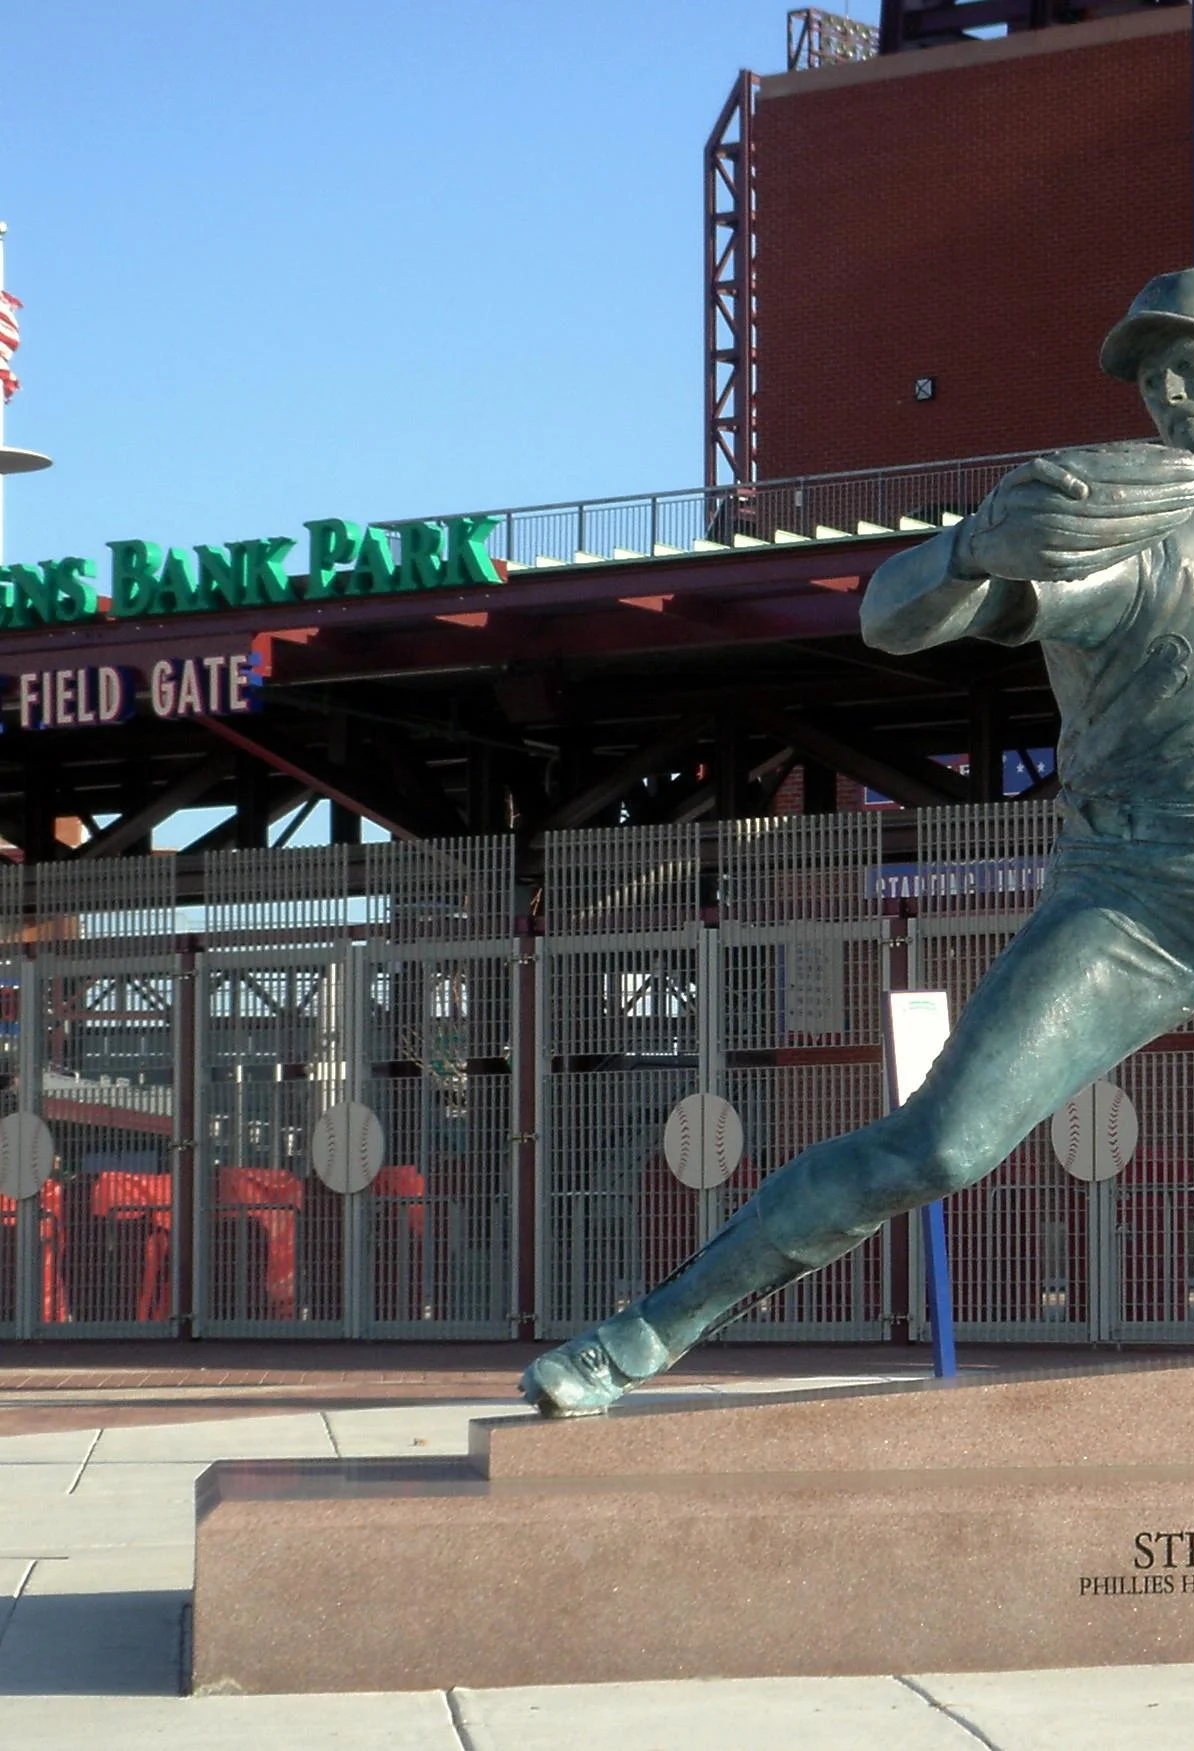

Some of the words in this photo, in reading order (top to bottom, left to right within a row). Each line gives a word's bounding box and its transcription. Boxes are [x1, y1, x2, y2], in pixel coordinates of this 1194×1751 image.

[107, 538, 298, 618] BANK
[303, 517, 501, 600] PARK
[19, 665, 124, 730] FIELD
[150, 653, 251, 720] GATE
[1079, 1574, 1175, 1597] PHILLIES
